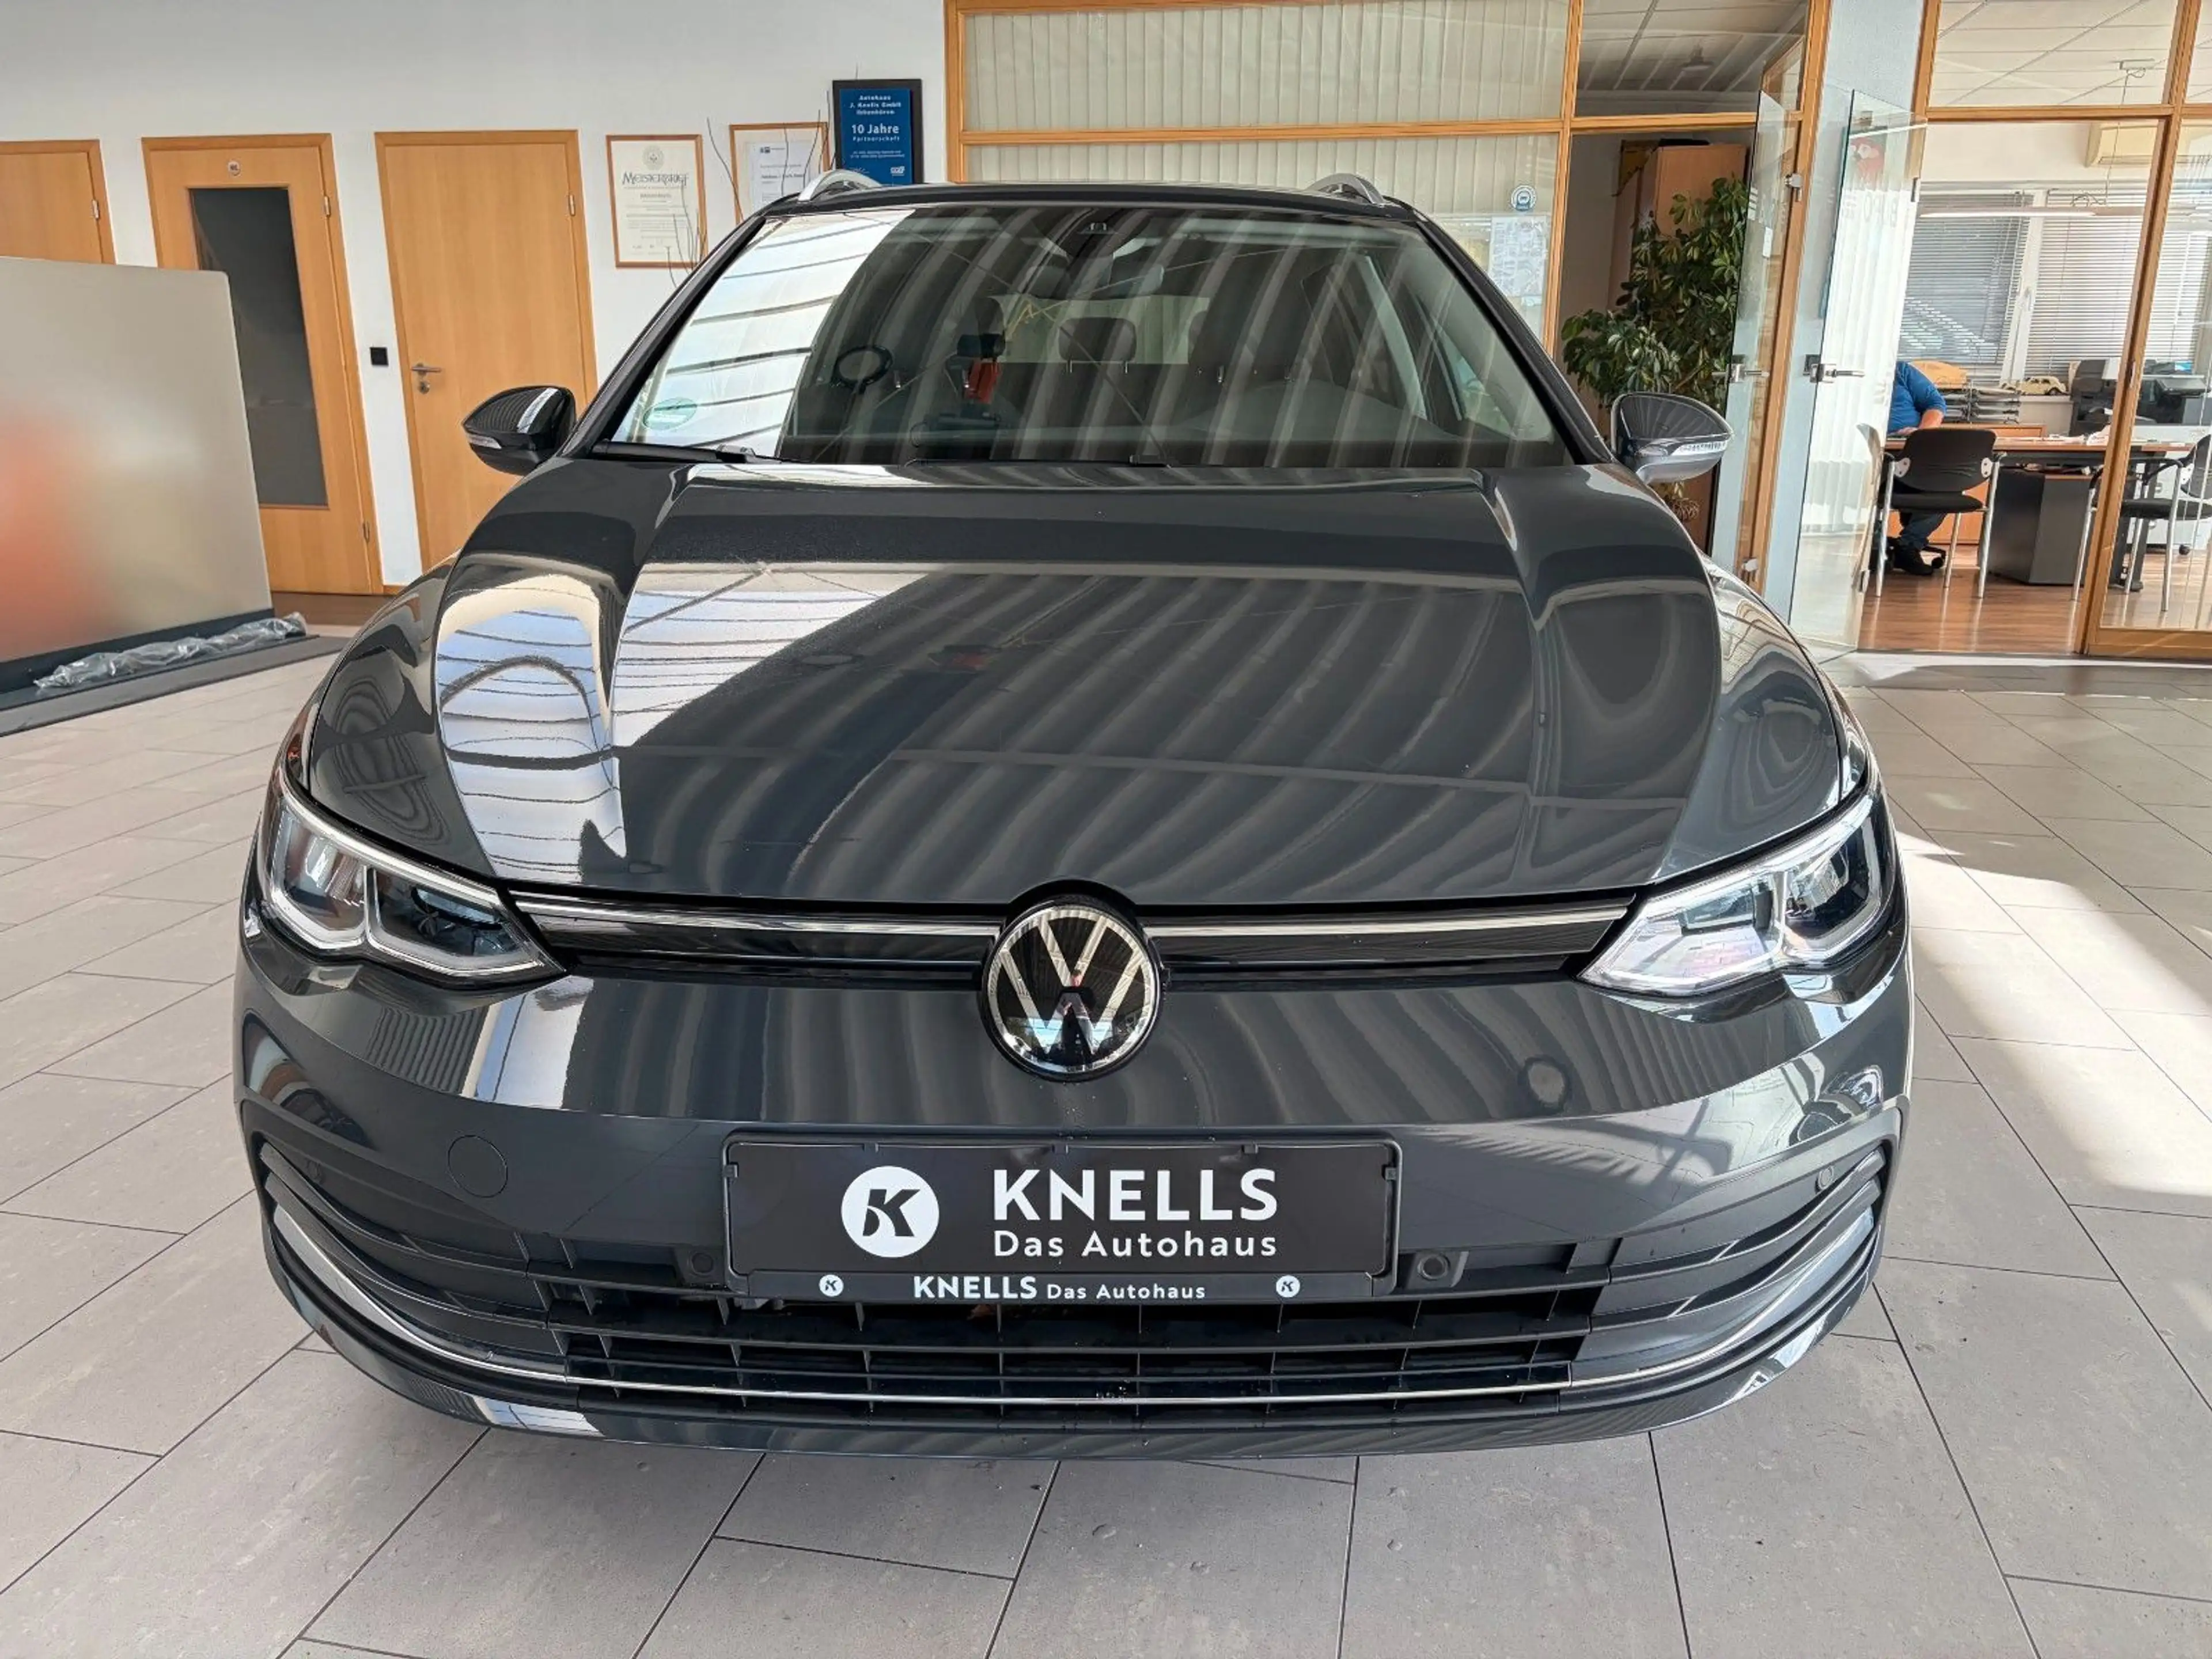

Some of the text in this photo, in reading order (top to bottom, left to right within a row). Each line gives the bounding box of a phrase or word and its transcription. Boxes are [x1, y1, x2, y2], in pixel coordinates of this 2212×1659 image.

[851, 123, 899, 134] 10 Jahre
[994, 1168, 1278, 1221] KNELLS
[994, 1230, 1277, 1257] Das Autohaus
[914, 1275, 1206, 1299] KNELLS Das Autohaus
